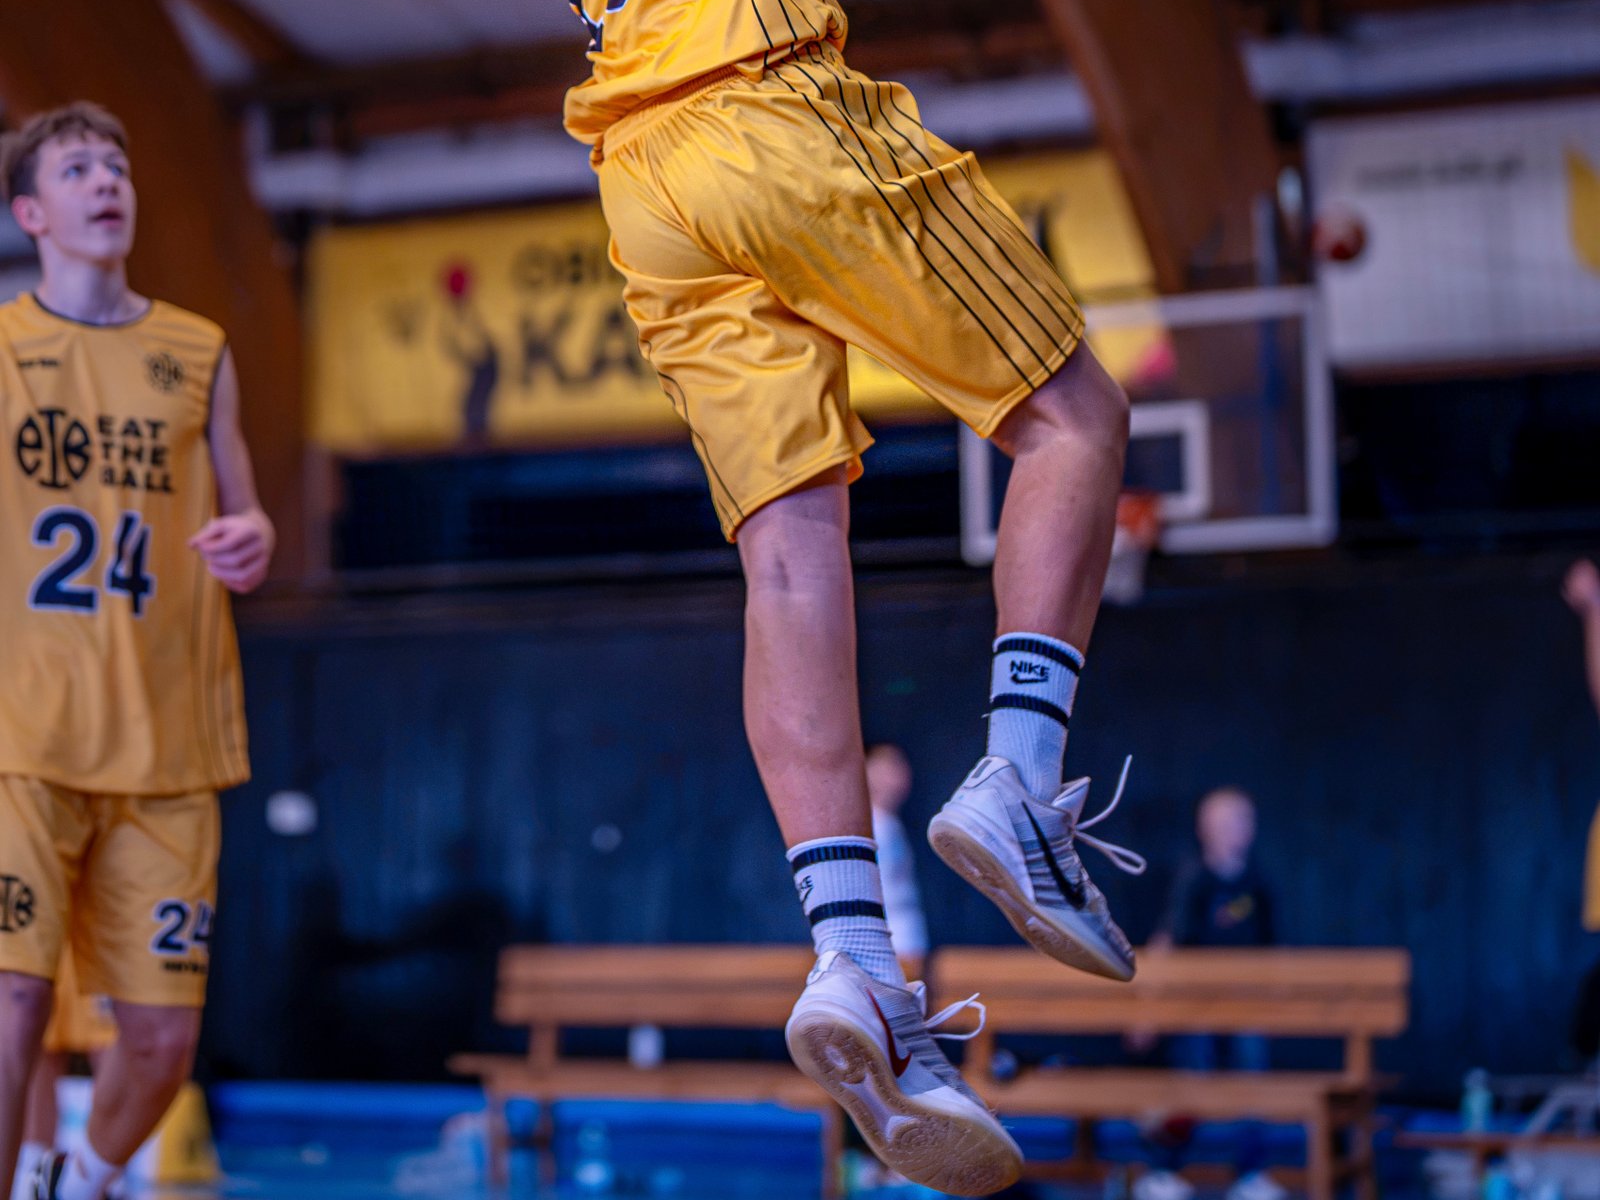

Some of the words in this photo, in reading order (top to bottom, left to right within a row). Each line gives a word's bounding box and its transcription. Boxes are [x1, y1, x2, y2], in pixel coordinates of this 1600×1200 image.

[97, 415, 167, 439] EAT
[101, 441, 169, 467] THE
[103, 466, 174, 493] BALL
[28, 505, 155, 619] 24
[1010, 660, 1050, 678] NIKE
